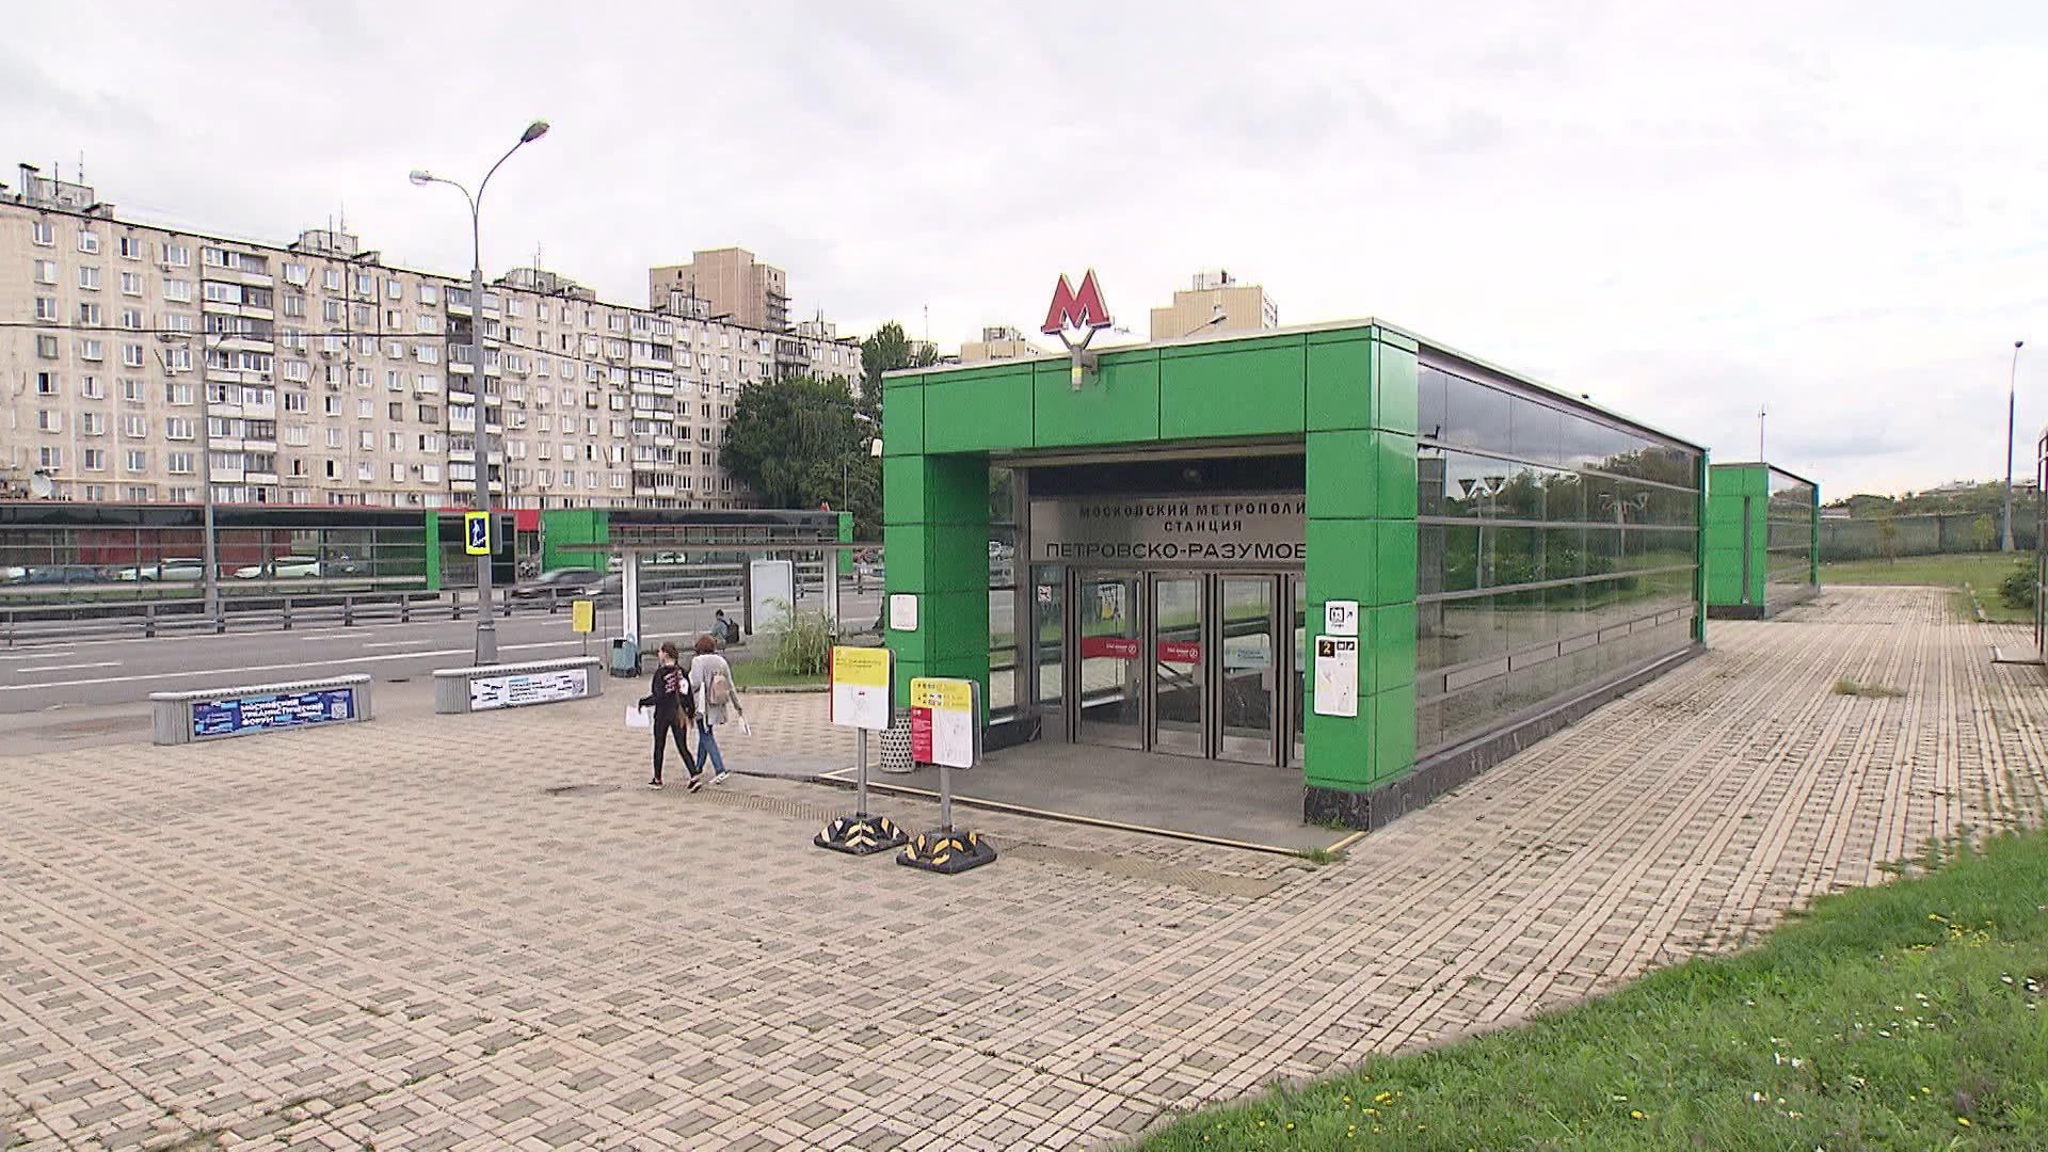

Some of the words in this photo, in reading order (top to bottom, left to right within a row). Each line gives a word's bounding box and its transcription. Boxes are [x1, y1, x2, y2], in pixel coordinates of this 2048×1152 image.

[1041, 268, 1111, 334] М
[1080, 502, 1188, 517] МОСКОВСКИЙ
[1164, 520, 1241, 533] СТАНЦИЯ
